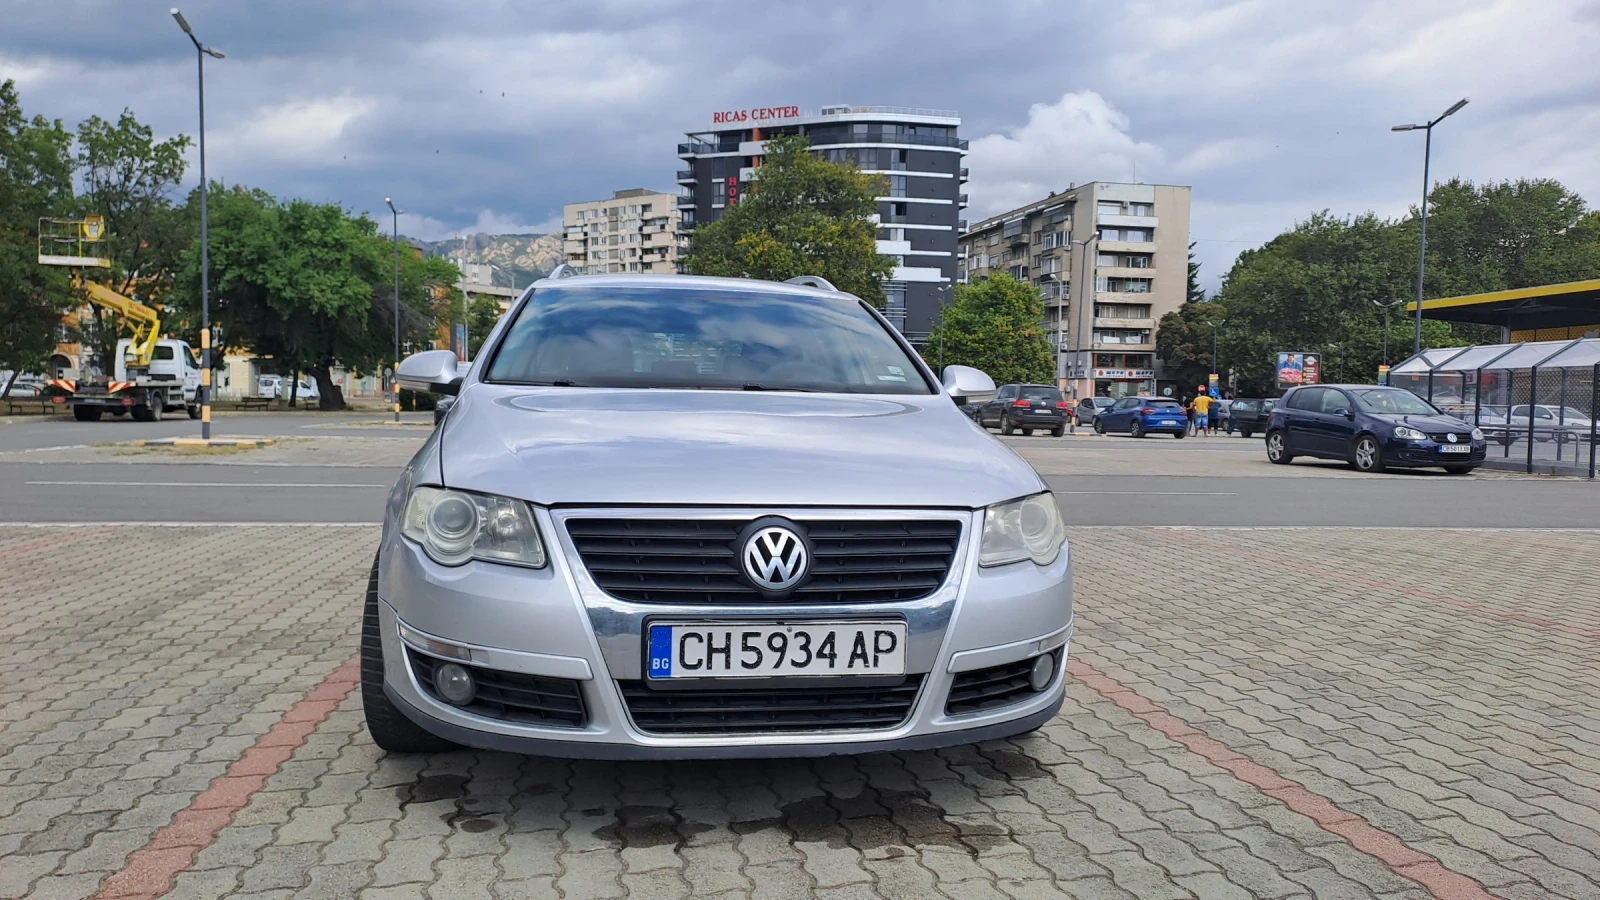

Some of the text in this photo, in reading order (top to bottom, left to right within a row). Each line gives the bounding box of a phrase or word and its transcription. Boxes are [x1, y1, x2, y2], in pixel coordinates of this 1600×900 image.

[713, 106, 799, 123] RICAS CENTER
[745, 527, 807, 589] VW
[652, 658, 670, 670] BG
